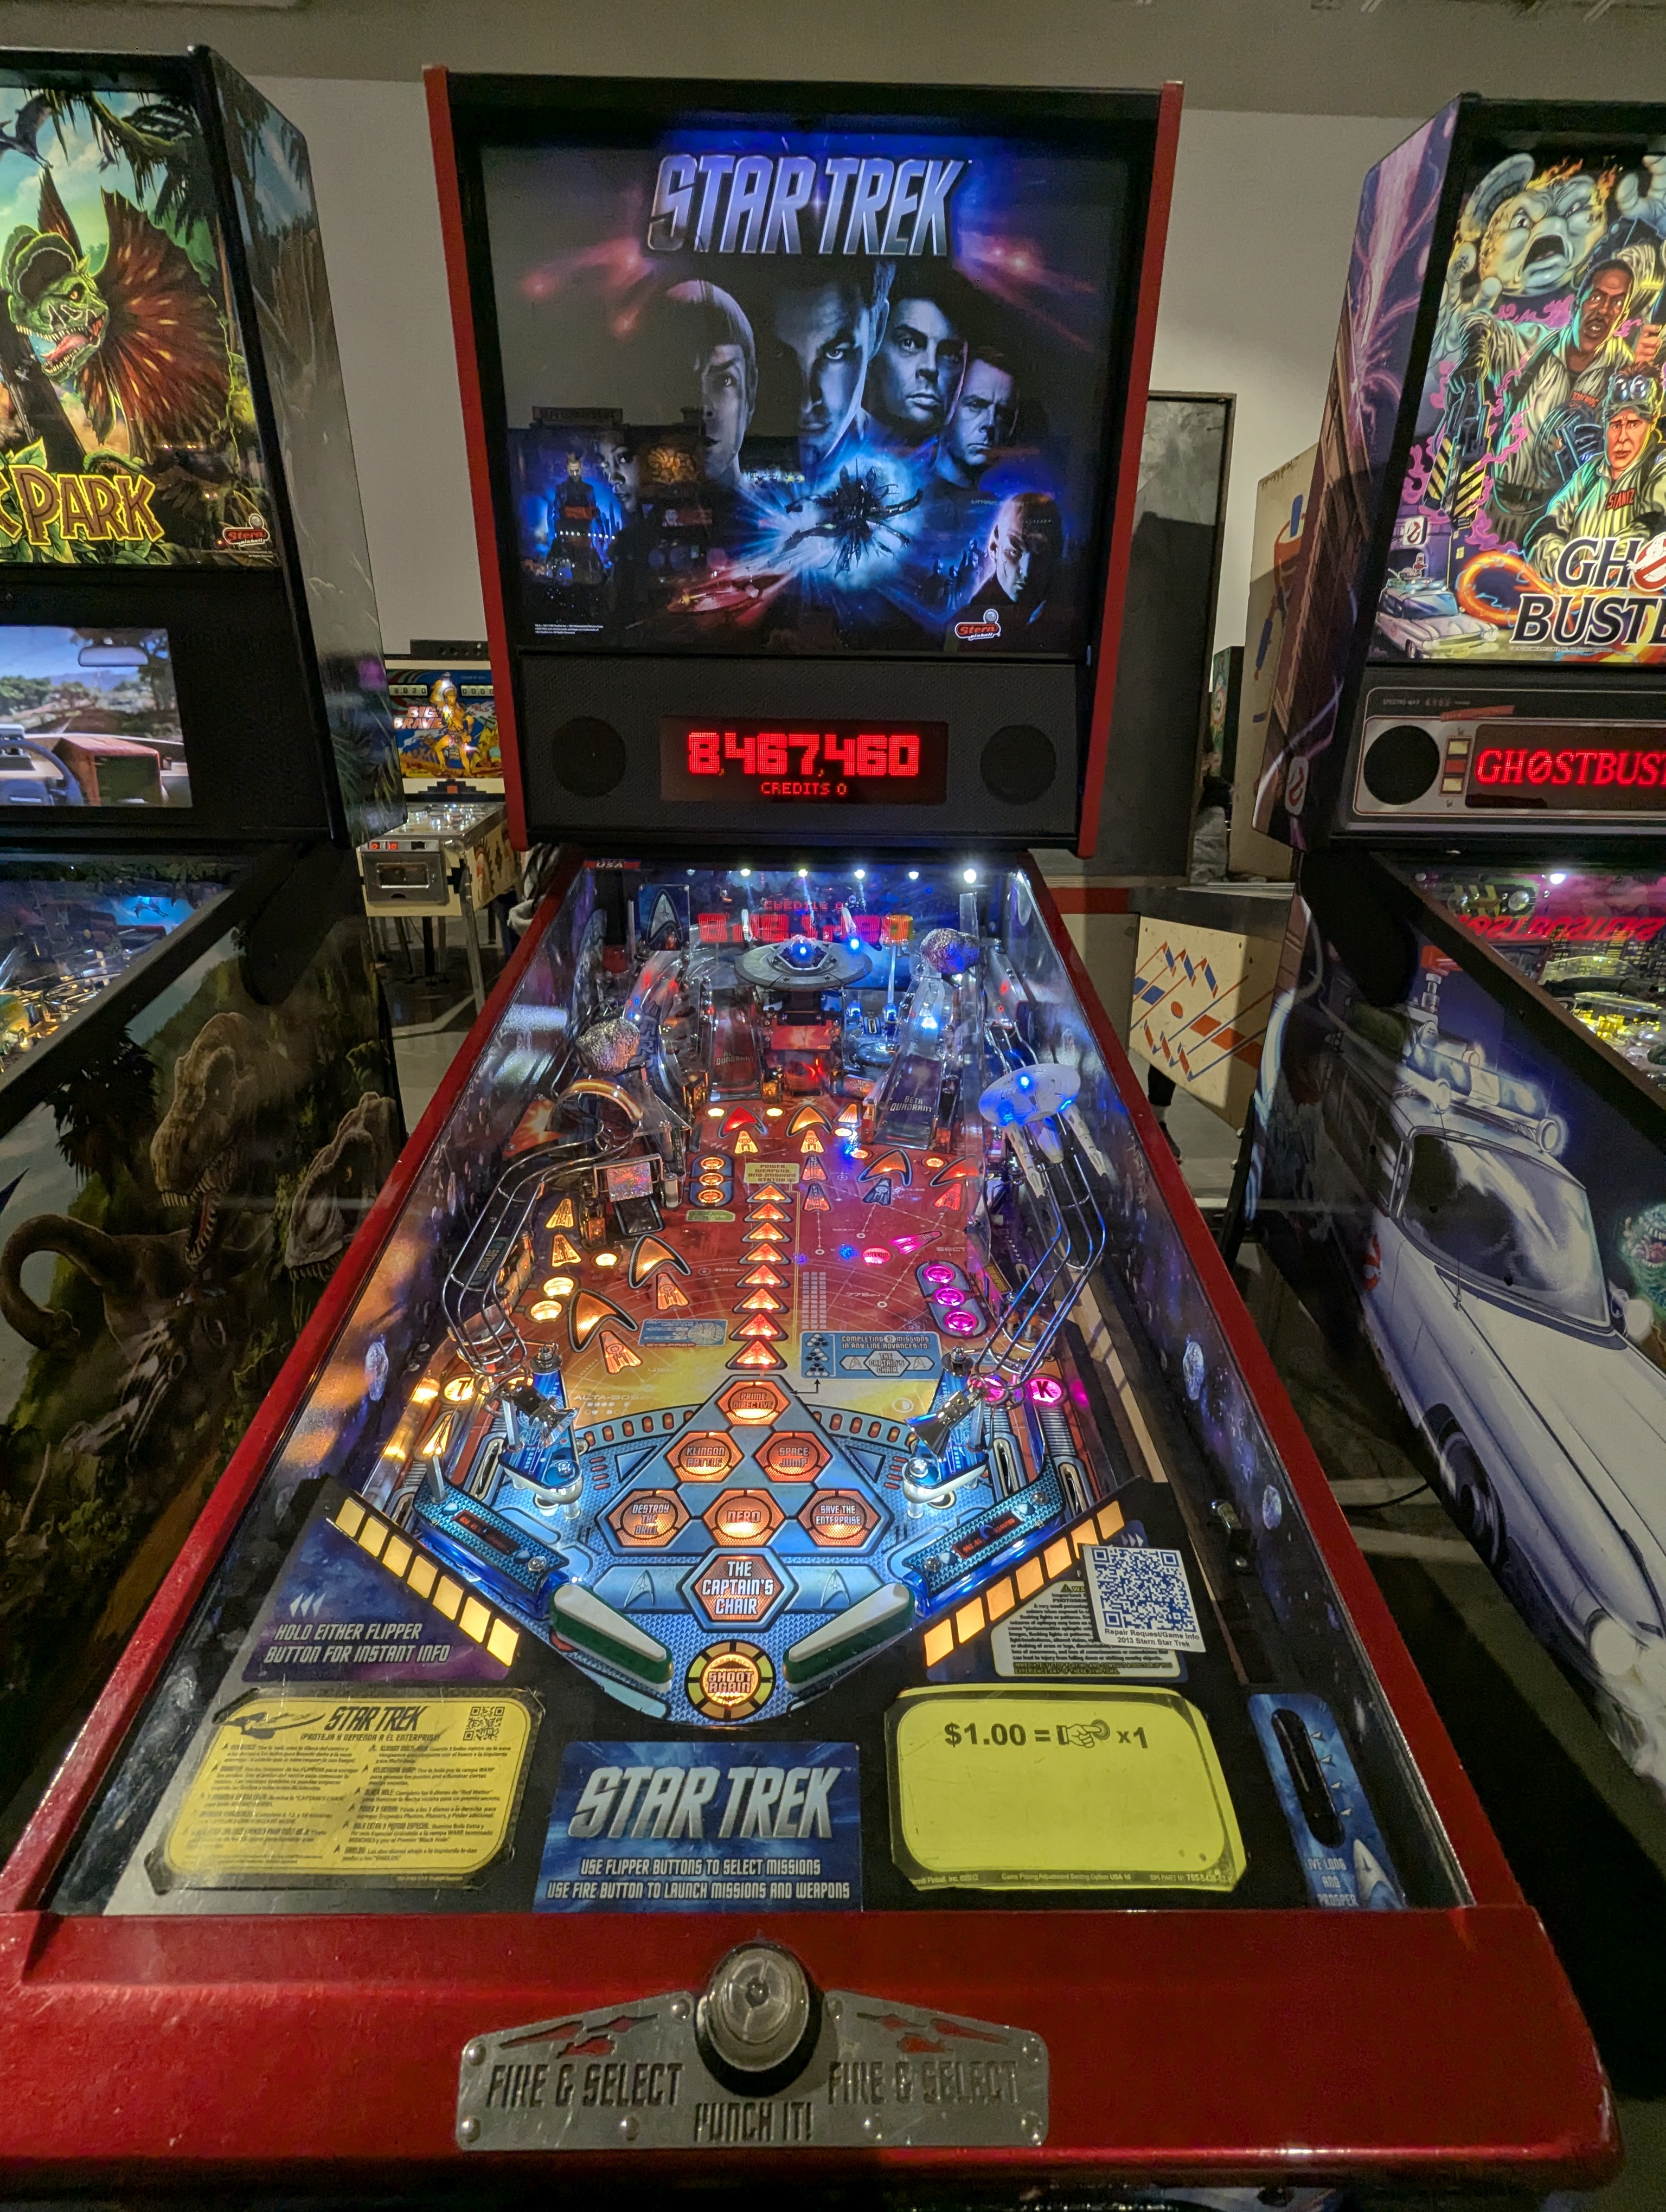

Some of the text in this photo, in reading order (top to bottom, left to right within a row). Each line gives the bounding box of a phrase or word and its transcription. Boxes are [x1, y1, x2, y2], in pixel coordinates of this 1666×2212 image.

[648, 155, 965, 256] STAR TREK
[9, 465, 165, 545] PARK
[1607, 489, 1635, 509] STANTZ
[960, 625, 996, 635] Stern
[407, 706, 438, 718] BIG
[393, 718, 444, 729] BRAVE
[688, 732, 919, 776] 8,467,460
[761, 782, 847, 795] CREDITS 0
[904, 1095, 924, 1105] BETA
[890, 1103, 933, 1113] QUADRANT
[1036, 1381, 1050, 1398] K
[740, 1392, 767, 1401] PRIME
[733, 1401, 773, 1409] DIRECTIVE
[686, 1446, 725, 1456] KLINGON
[779, 1446, 809, 1456] SPACE
[687, 1457, 722, 1467] BATTLE
[780, 1458, 807, 1467] JUMP
[632, 1504, 670, 1514] DESTROY
[821, 1505, 856, 1514] SAVE THE
[642, 1514, 657, 1522] THE
[727, 1510, 761, 1522] NERO
[816, 1516, 861, 1525] ENTERPRISE
[635, 1526, 658, 1535] DRILL
[727, 1561, 752, 1577] THE
[702, 1579, 774, 1595] CAPTAIN'S
[715, 1598, 758, 1615] CHAIR
[274, 1623, 422, 1641] HOLD EITHER FLIPPER
[1130, 1629, 1184, 1638] Request/Game
[264, 1645, 451, 1663] BUTTON FOR INSTANT INFO
[708, 1671, 754, 1682] SHOOT
[709, 1682, 751, 1693] AGAIN
[324, 1706, 428, 1731] STAR TREK
[379, 1733, 383, 1741] A
[944, 1721, 1027, 1748] $1.00
[568, 1766, 841, 1838] STAR TREK
[581, 1859, 821, 1875] USE FLIPPER BUTTONS TO SELECT MISSIONS
[1324, 1857, 1347, 1870] LONG
[1322, 1875, 1341, 1888] AND
[547, 1882, 850, 1899] USE FIRE BUTTON TO LAUNCH MISSIONS AND WEAPONS
[486, 2063, 546, 2108] FIRE
[582, 2062, 682, 2107] SELECT
[919, 2060, 1019, 2105] SELECT
[694, 2100, 814, 2143] PUNCH IT!
